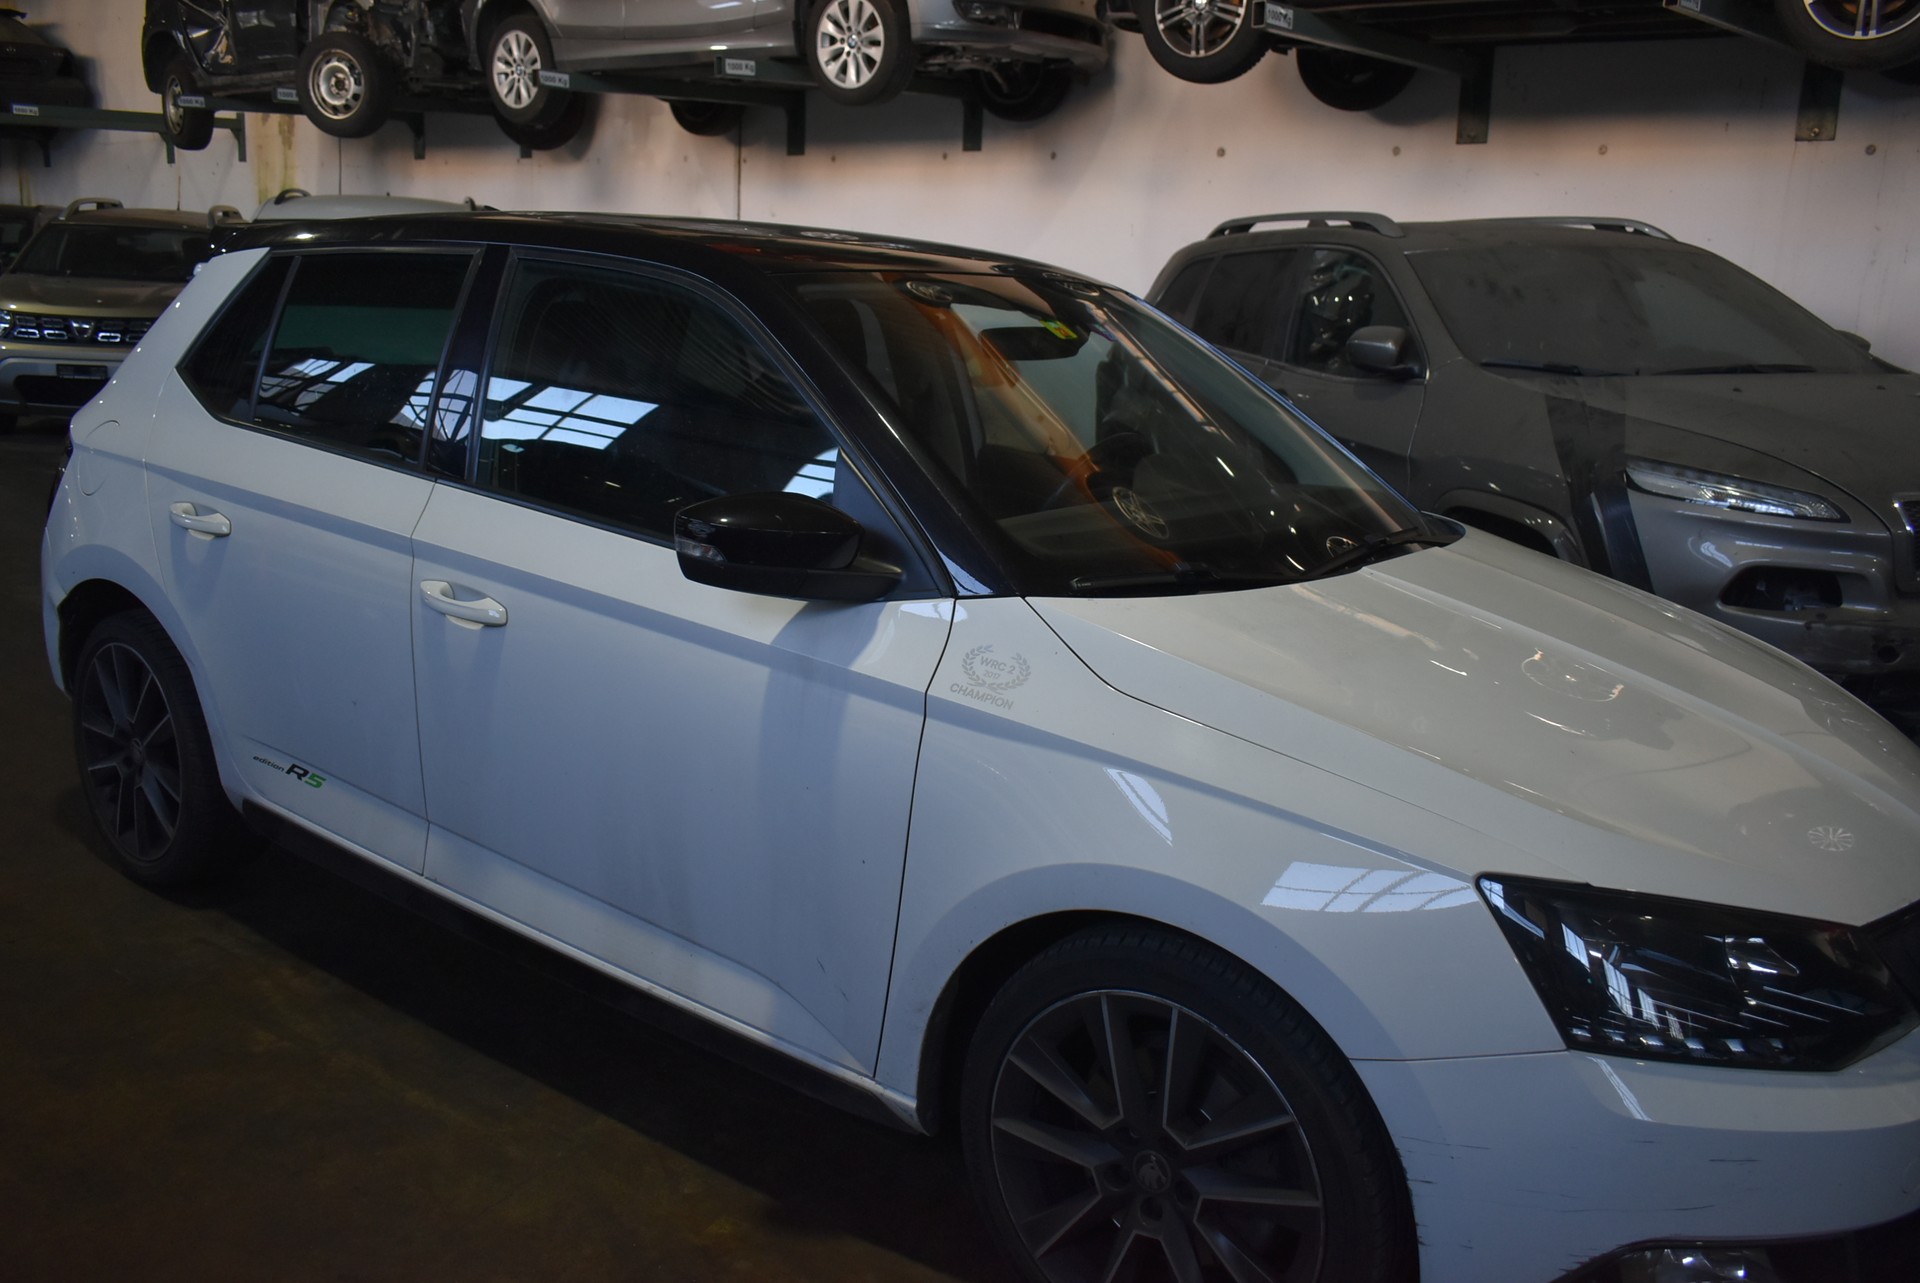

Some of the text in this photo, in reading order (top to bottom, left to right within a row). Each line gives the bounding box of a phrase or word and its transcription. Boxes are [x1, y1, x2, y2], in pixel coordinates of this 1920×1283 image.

[980, 655, 1016, 675] WRC 2
[949, 682, 1014, 710] CHAMPION
[252, 755, 285, 773] edition
